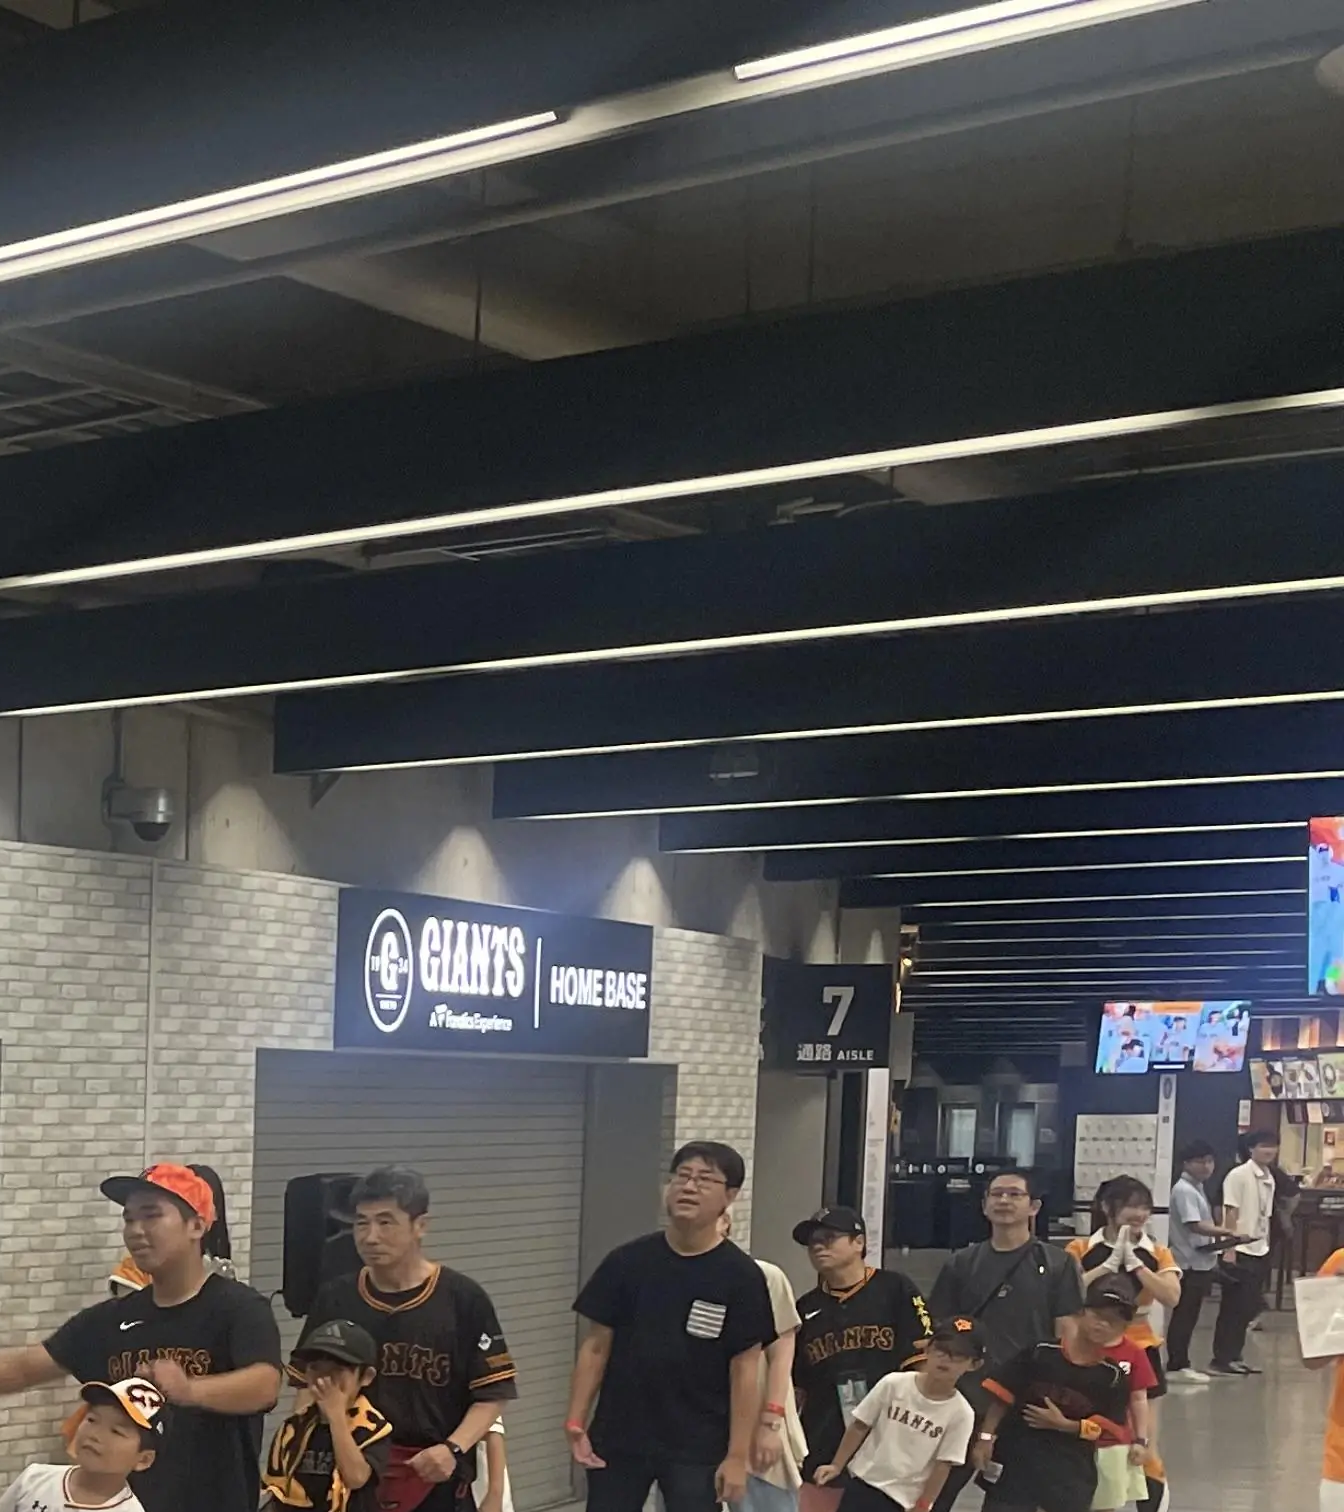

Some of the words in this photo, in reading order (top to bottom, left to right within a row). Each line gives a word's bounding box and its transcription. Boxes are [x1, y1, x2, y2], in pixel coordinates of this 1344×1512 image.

[419, 916, 526, 998] GIANTS
[550, 965, 603, 1006] HOME
[604, 969, 647, 1010] BASE
[822, 986, 855, 1036] 7
[797, 1043, 832, 1061] 通路
[837, 1050, 874, 1061] AISLE
